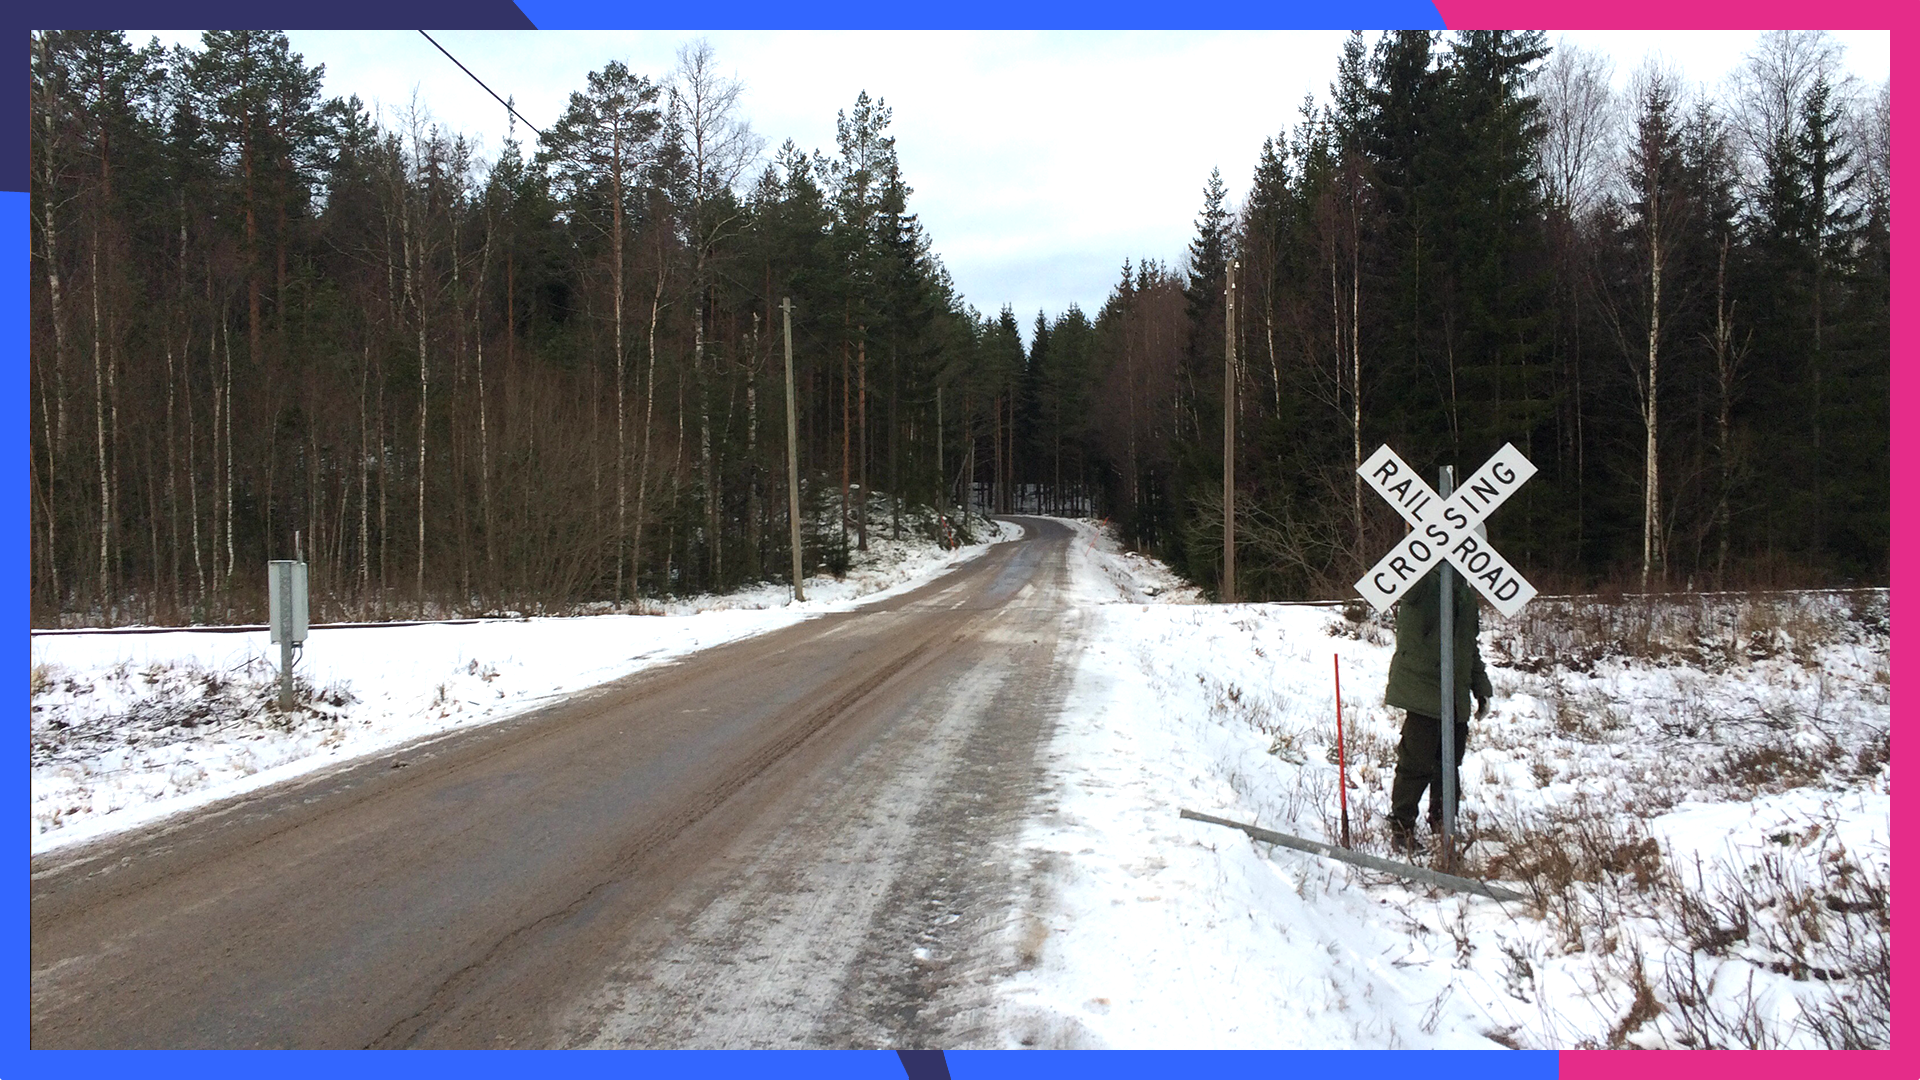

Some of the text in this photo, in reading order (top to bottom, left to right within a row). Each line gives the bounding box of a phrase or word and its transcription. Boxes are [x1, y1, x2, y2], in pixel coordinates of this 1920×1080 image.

[1373, 459, 1520, 601] RAIL ROAD
[1374, 462, 1516, 595] CROSSING
